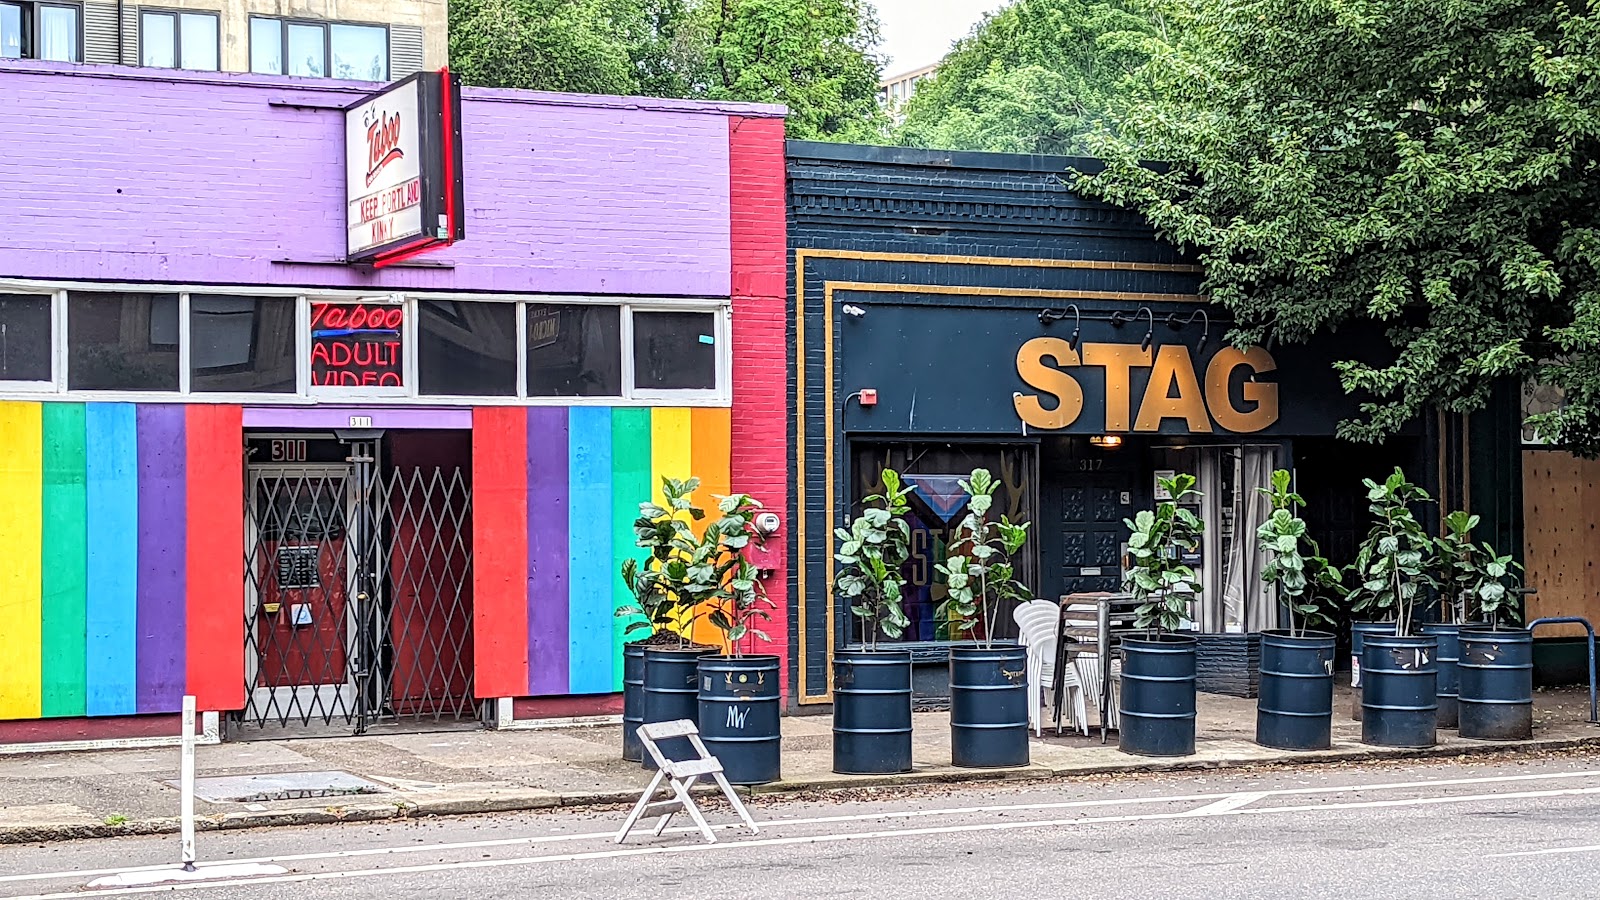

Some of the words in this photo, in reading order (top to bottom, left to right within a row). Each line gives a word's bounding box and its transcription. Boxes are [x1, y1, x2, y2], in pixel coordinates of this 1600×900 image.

[366, 110, 401, 173] Taboo
[360, 197, 378, 225] KEEP
[382, 180, 419, 215] PORTLAND
[311, 342, 400, 366] ADULT
[1014, 337, 1279, 434] STAG
[351, 418, 369, 427] 311
[271, 440, 306, 461] 311
[1080, 459, 1103, 471] 317
